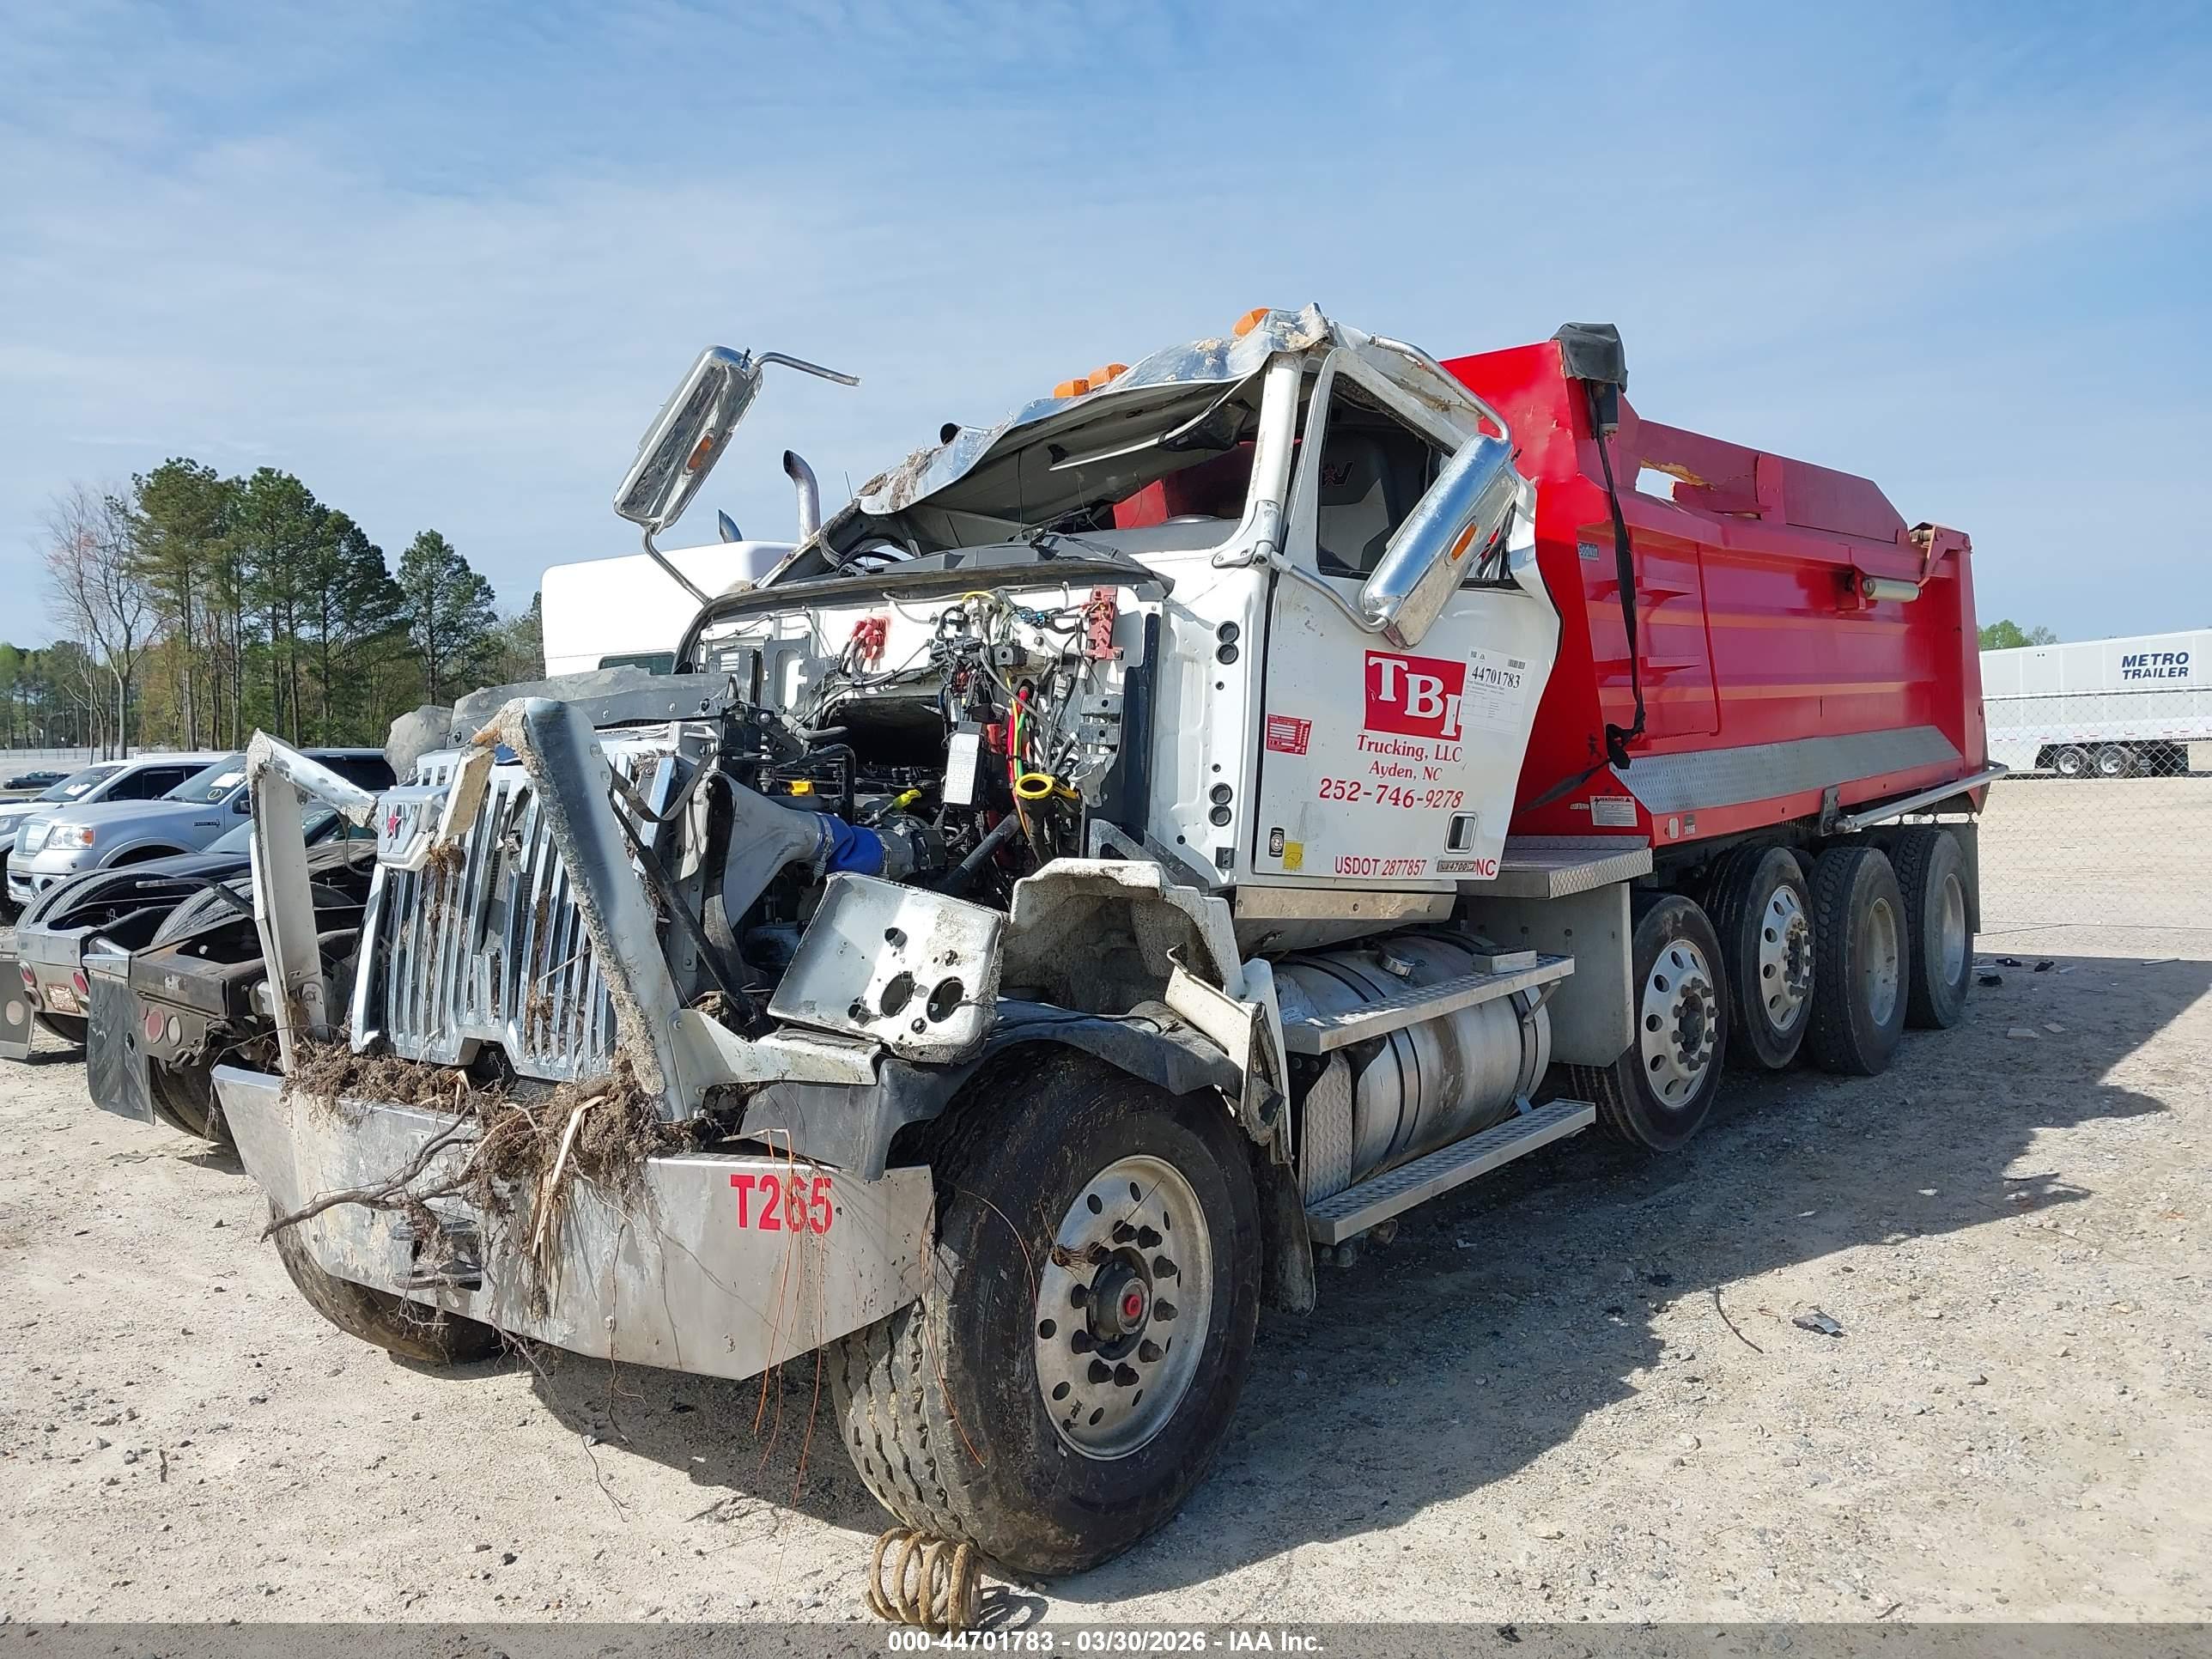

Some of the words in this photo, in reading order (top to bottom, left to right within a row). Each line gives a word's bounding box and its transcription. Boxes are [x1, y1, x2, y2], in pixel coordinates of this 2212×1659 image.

[2121, 651, 2190, 668] METRO
[1471, 665, 1522, 689] 44701783
[2122, 666, 2190, 681] TRAILER
[1368, 656, 1462, 737] TBI
[1357, 733, 1429, 763] Trucking,
[1434, 744, 1463, 763] LLC
[1368, 760, 1418, 781] Ayden,
[1421, 766, 1443, 781] NC
[1319, 778, 1464, 809] 252-746-9278
[1334, 855, 1381, 876] USDOT
[1381, 858, 1427, 876] 2877857
[1476, 858, 1497, 877] NC
[730, 1174, 833, 1234] T265
